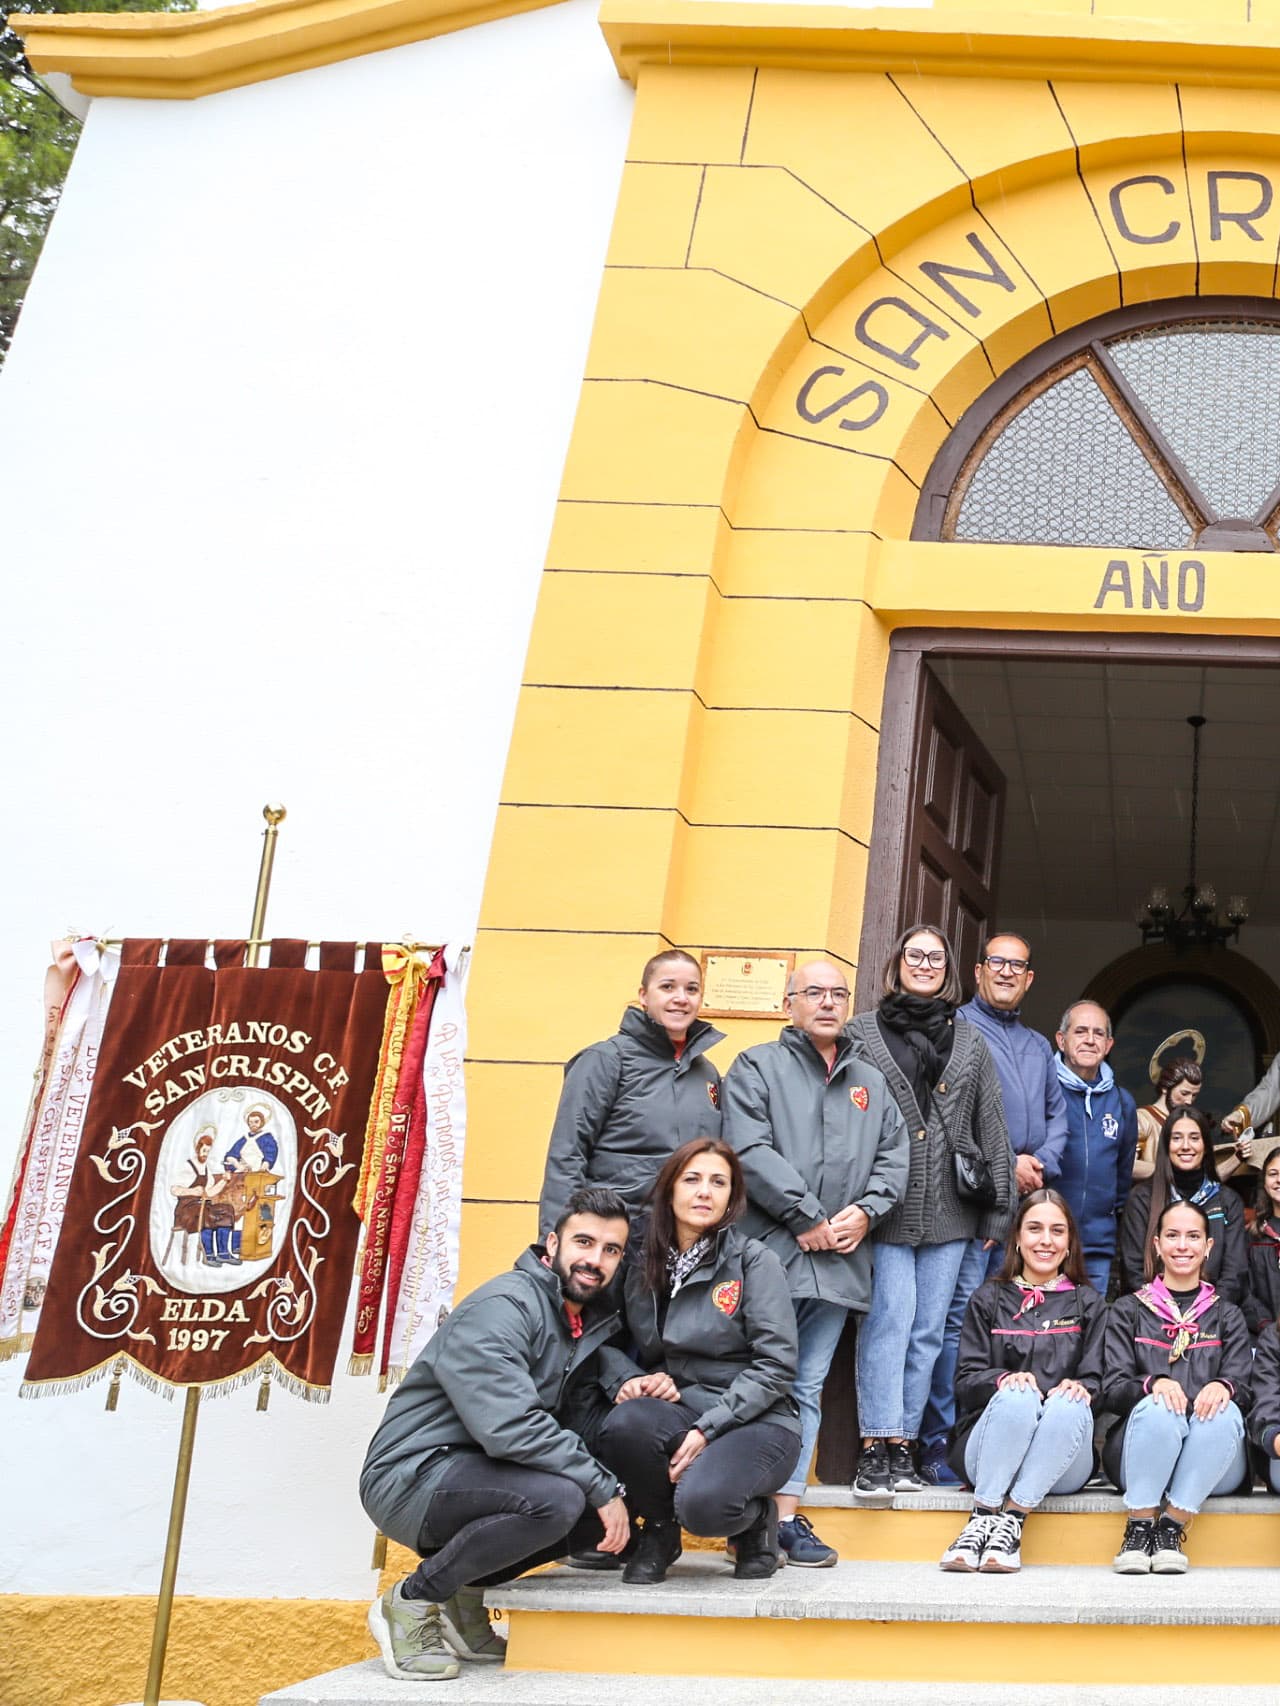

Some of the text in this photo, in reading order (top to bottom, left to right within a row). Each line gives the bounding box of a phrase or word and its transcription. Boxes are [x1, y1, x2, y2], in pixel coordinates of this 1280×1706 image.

[795, 231, 1017, 431] SAN
[1093, 552, 1206, 612] AÑO
[122, 1021, 312, 1090] VETERANOS
[313, 1052, 350, 1096] C.F.
[144, 1054, 331, 1121] SAN CRISPIN
[36, 1064, 72, 1192] SAN CRISPIN
[50, 1094, 87, 1213] VETERANOS
[430, 1084, 457, 1173] PATRONOS
[373, 1114, 407, 1277] DE SARA NAVARRO
[159, 1298, 251, 1322] ELDA
[166, 1327, 231, 1352] 1997
